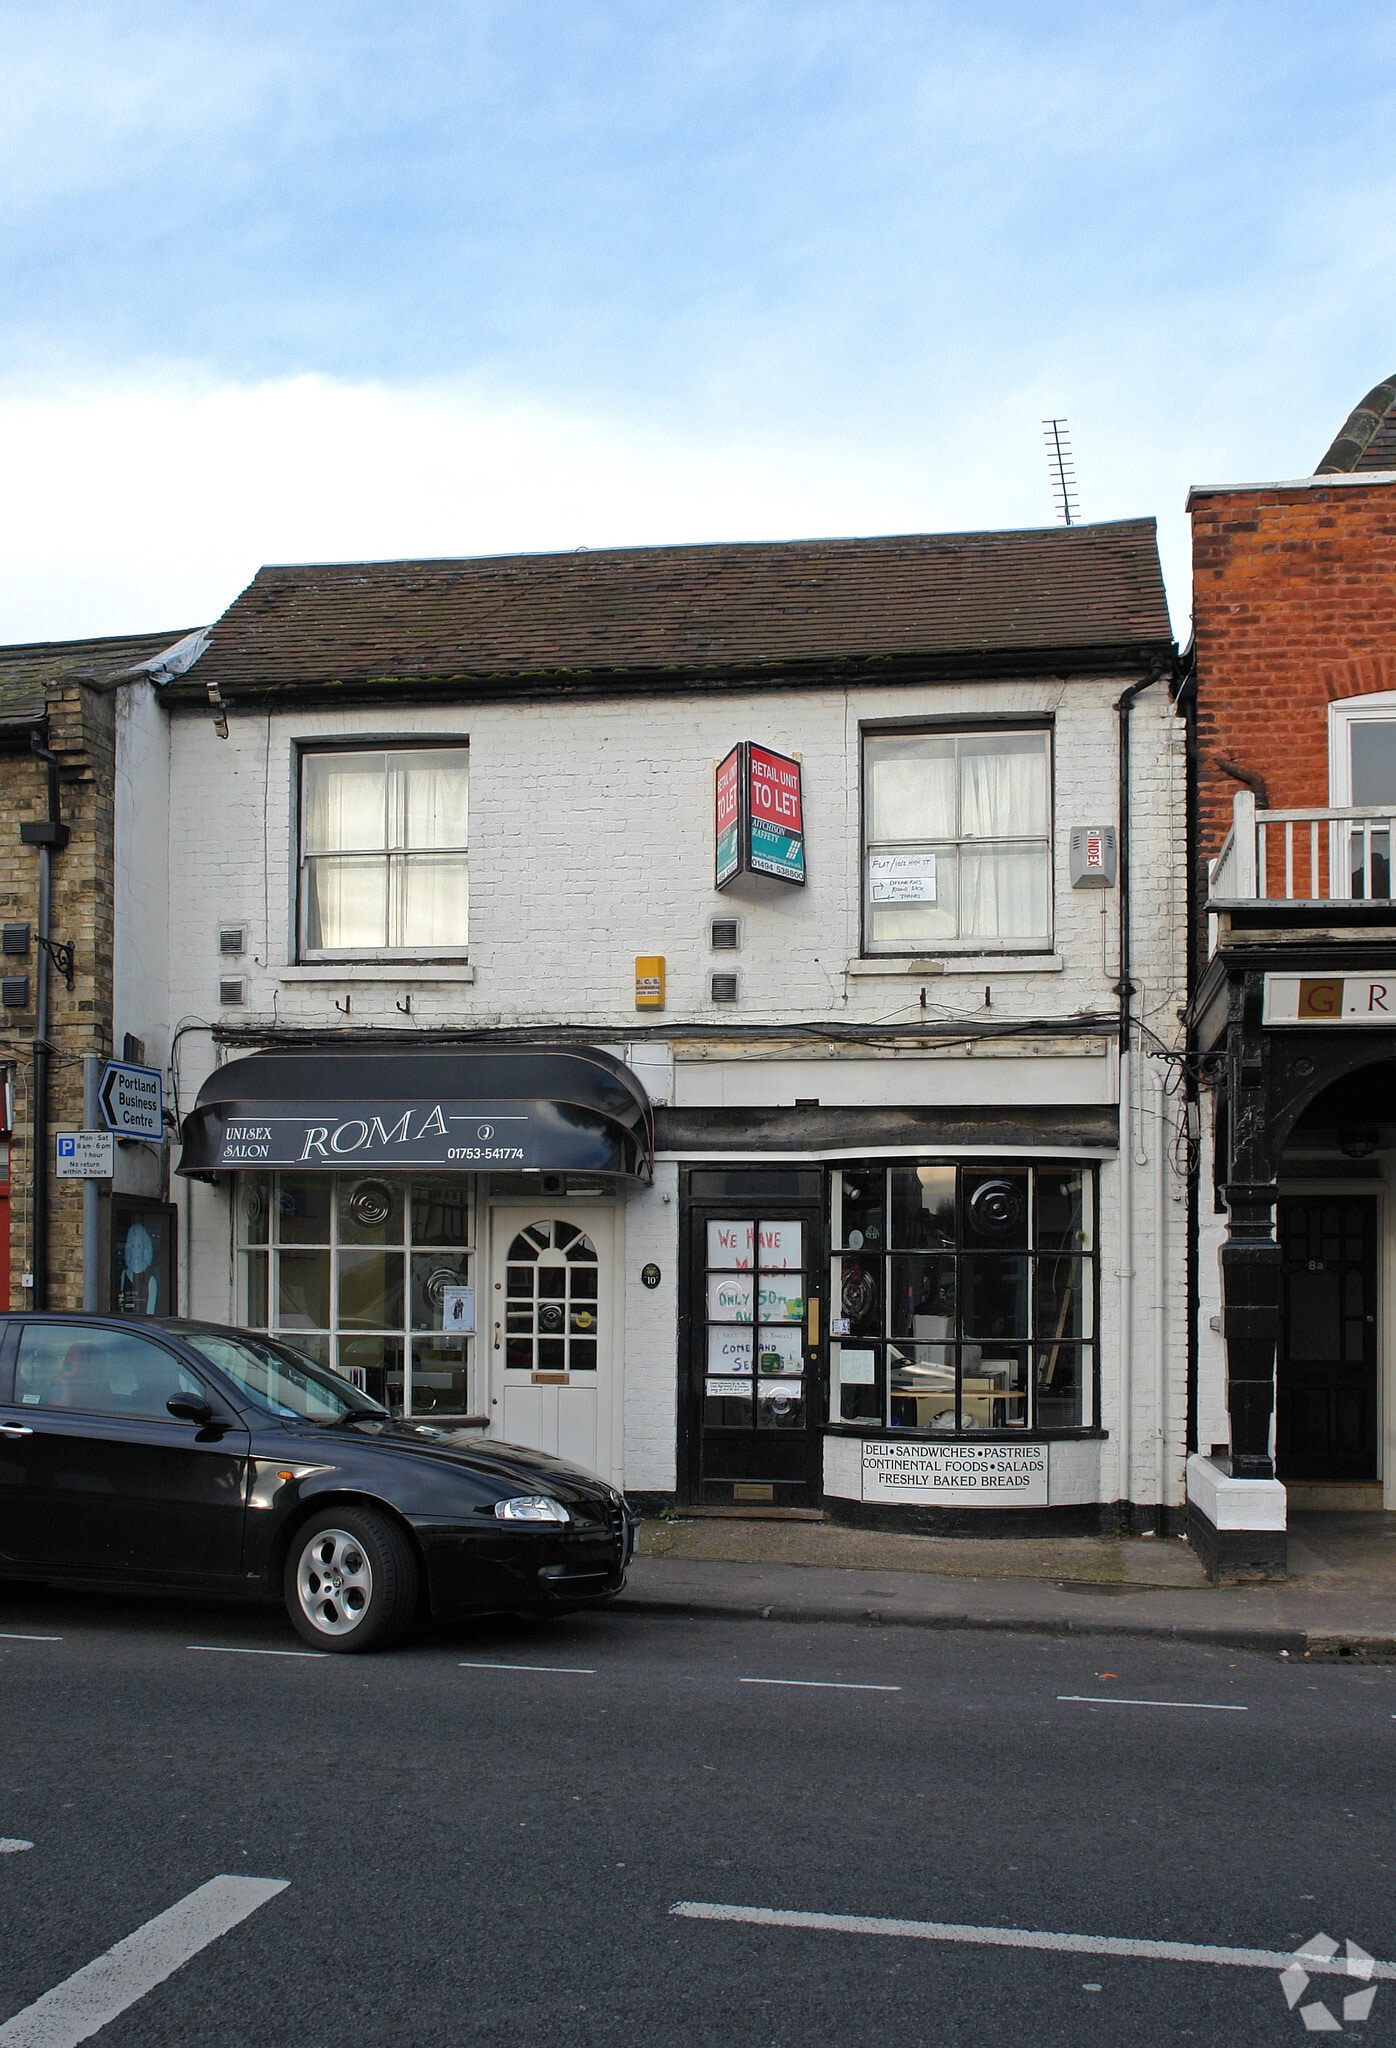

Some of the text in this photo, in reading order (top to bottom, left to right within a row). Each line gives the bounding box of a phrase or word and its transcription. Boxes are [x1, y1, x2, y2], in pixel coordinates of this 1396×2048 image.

[752, 759, 798, 790] RETAIL UNIT
[717, 782, 738, 821] TO LET
[753, 781, 798, 818] TO LET
[751, 818, 786, 836] AITCHISON
[752, 827, 780, 844] RAFFETY
[751, 858, 774, 872] 01494
[776, 865, 804, 880] 538800
[118, 1074, 157, 1094] Portland
[119, 1092, 157, 1111] Business
[123, 1110, 153, 1127] Centre
[226, 1127, 272, 1140] UNISEX
[296, 1104, 450, 1162] ROMA
[223, 1145, 270, 1158] SALON
[447, 1147, 524, 1160] 01753-541774
[718, 1227, 782, 1249] WE HAVE
[1308, 1260, 1324, 1270] 8a
[647, 1276, 656, 1285] 10
[719, 1292, 750, 1307] ONLY
[722, 1343, 777, 1355] COME AND
[865, 1445, 1041, 1458] DELI SANDWICHES PASTRIES
[862, 1458, 1044, 1472] CONTINENTAL FOODS SALADS
[878, 1473, 1030, 1487] FRESHLY BAKED BREADS
